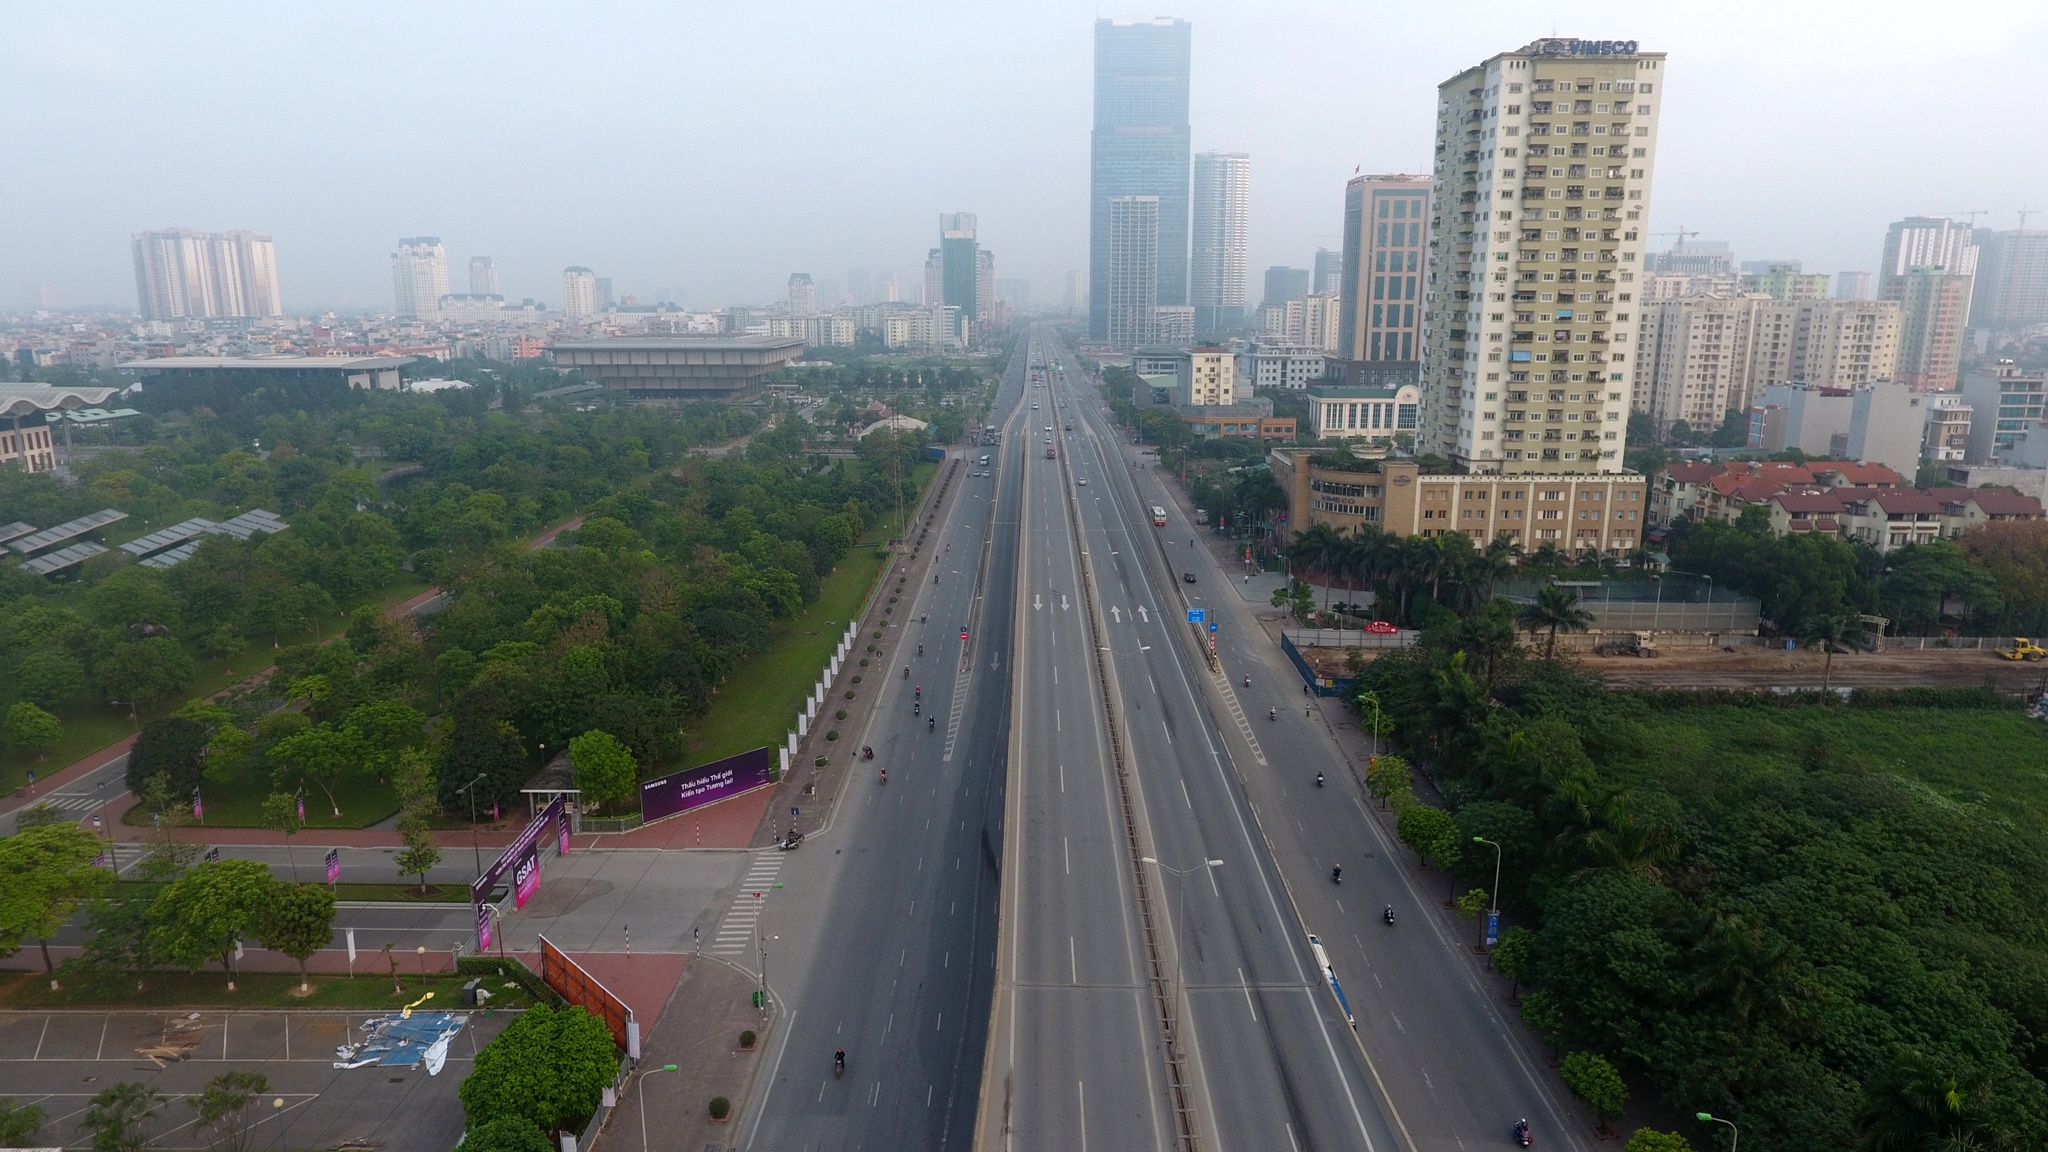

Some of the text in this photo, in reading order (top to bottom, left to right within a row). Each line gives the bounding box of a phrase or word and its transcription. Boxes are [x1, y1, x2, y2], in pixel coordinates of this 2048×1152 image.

[1569, 40, 1637, 55] VIMECO
[1321, 494, 1356, 505] VIMECO
[644, 780, 667, 790] SAMSUNG
[516, 854, 535, 885] GSAT
